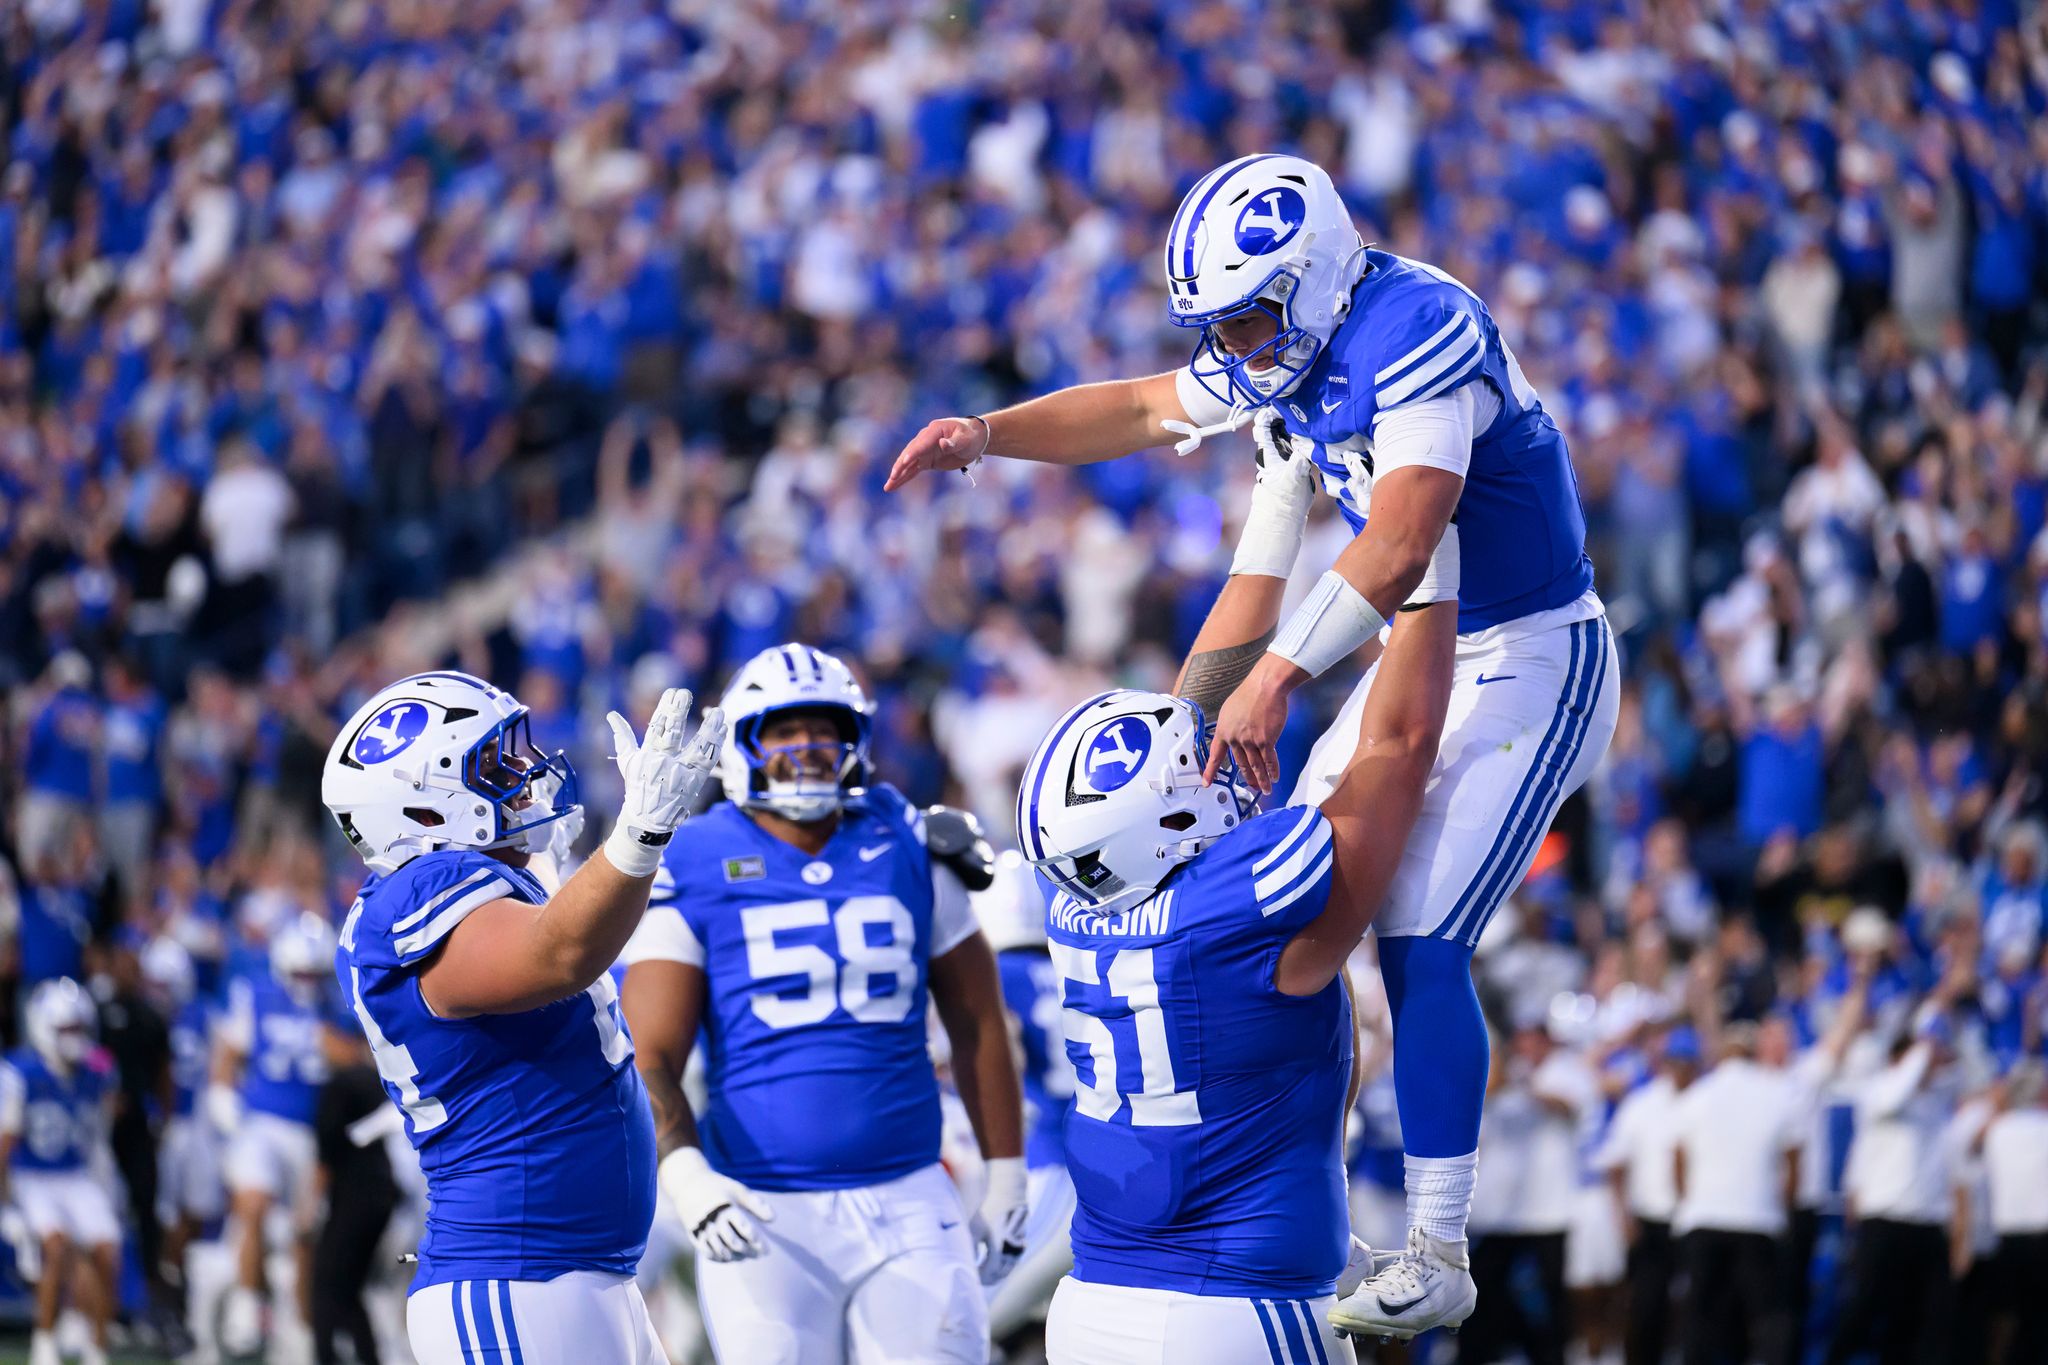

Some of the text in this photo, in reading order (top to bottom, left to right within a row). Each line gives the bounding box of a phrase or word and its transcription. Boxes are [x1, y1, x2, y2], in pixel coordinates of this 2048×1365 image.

[1240, 192, 1294, 243] Y
[1178, 298, 1193, 310] BYU
[361, 706, 412, 755] Y
[1089, 722, 1145, 773] Y
[740, 895, 918, 1029] 58
[1048, 937, 1203, 1127] 51
